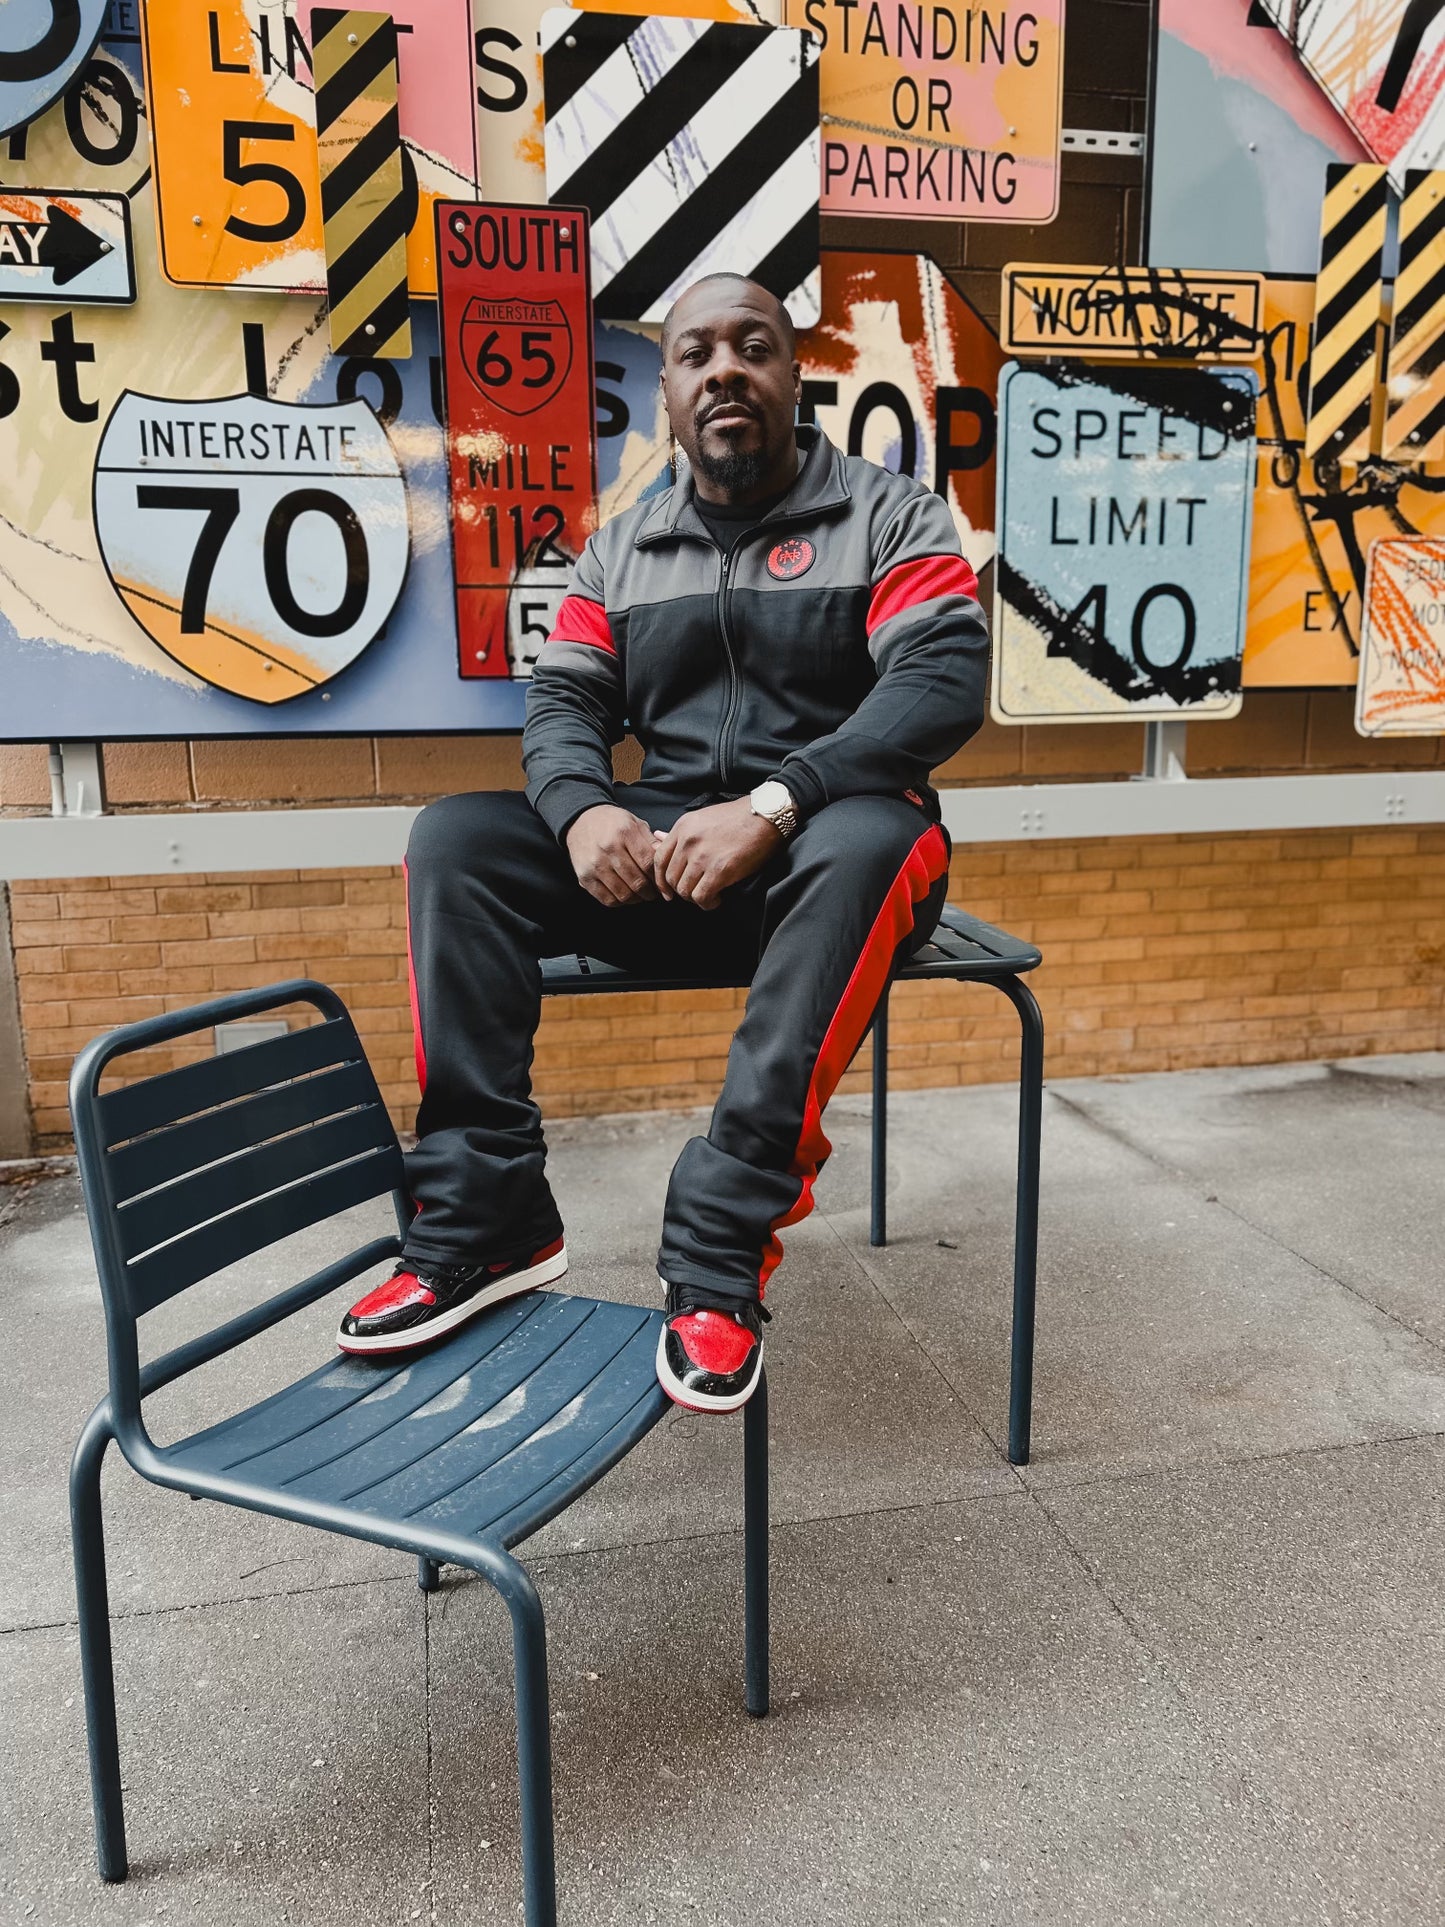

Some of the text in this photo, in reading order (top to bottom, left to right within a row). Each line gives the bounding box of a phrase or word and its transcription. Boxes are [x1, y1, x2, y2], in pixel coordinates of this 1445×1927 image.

[804, 0, 1040, 67] STANDING
[892, 76, 952, 132] OR
[824, 142, 1018, 204] PARKING
[448, 210, 578, 273] SOUTH
[478, 304, 552, 321] INTERSTATE
[477, 330, 555, 388] 65
[140, 420, 359, 462] INTERSTATE
[1031, 408, 1230, 461] SPEED
[469, 444, 574, 491] MILE
[484, 504, 567, 568] 112
[1051, 496, 1207, 546] LIMIT
[136, 484, 370, 638] 70
[1047, 582, 1197, 677] 40
